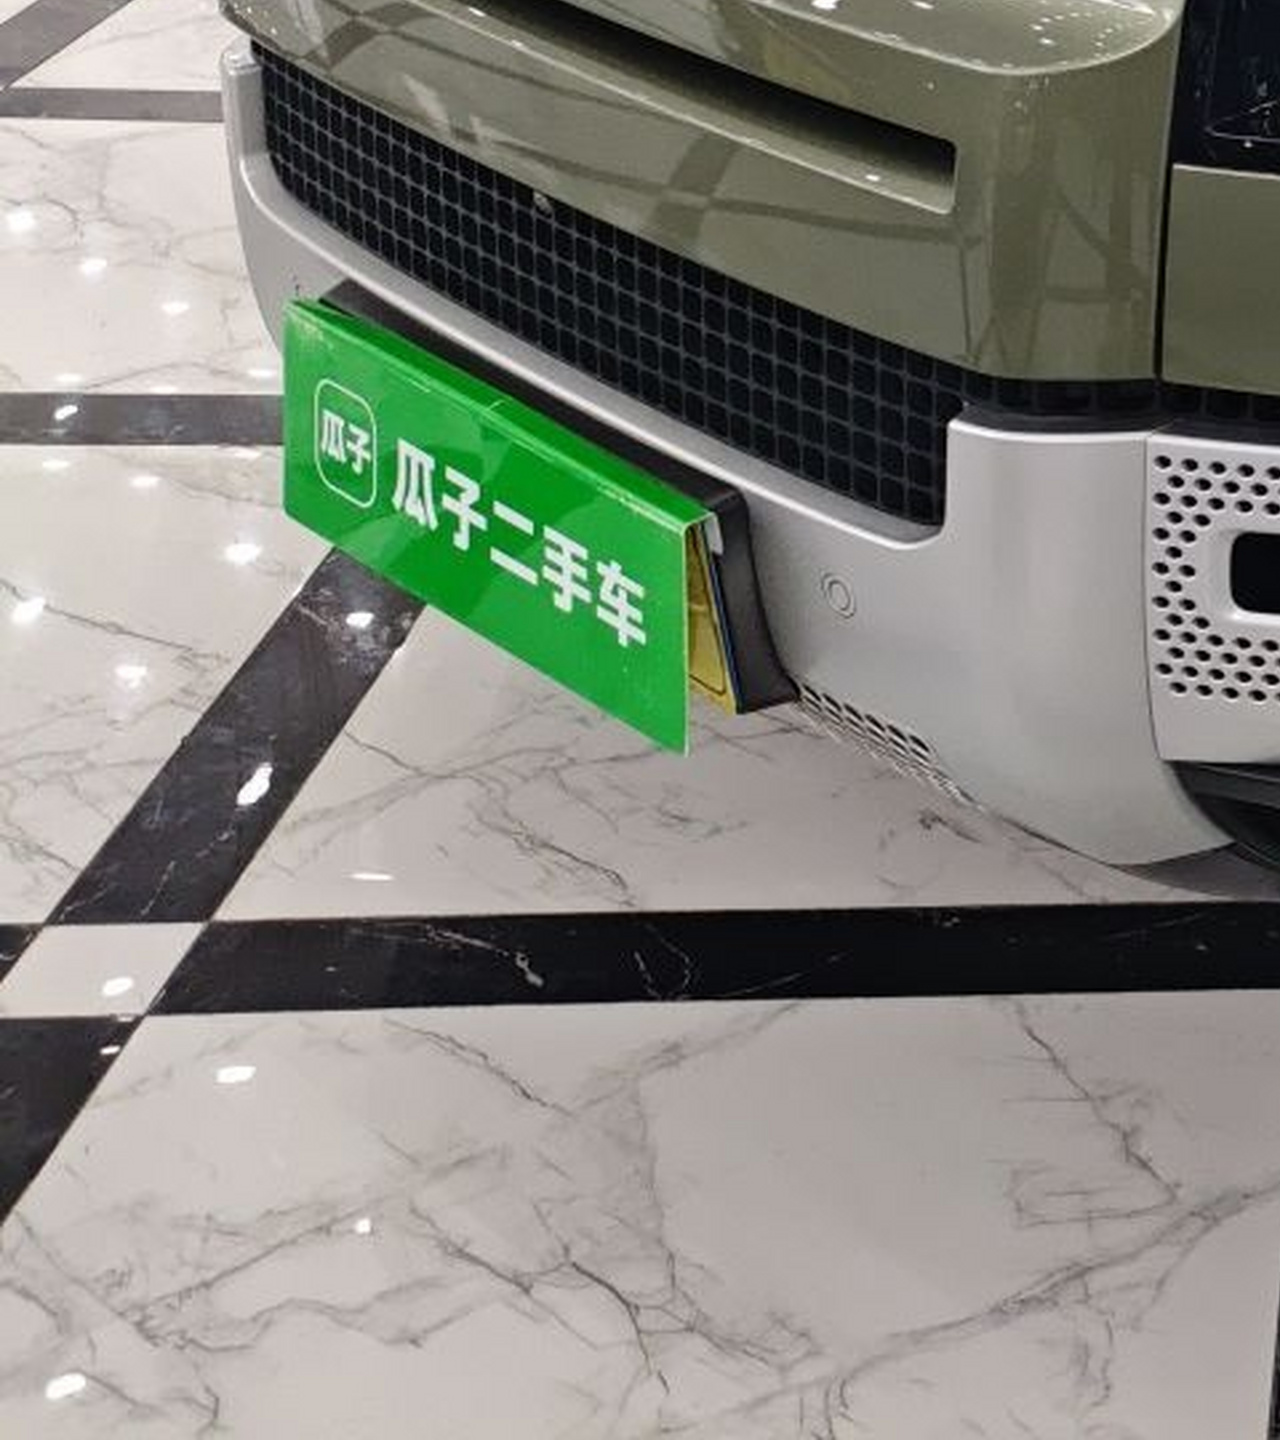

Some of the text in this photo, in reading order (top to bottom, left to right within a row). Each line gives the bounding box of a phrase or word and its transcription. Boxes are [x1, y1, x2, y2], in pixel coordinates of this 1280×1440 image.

[319, 409, 371, 474] 瓜子
[392, 438, 647, 647] 瓜子二手车
